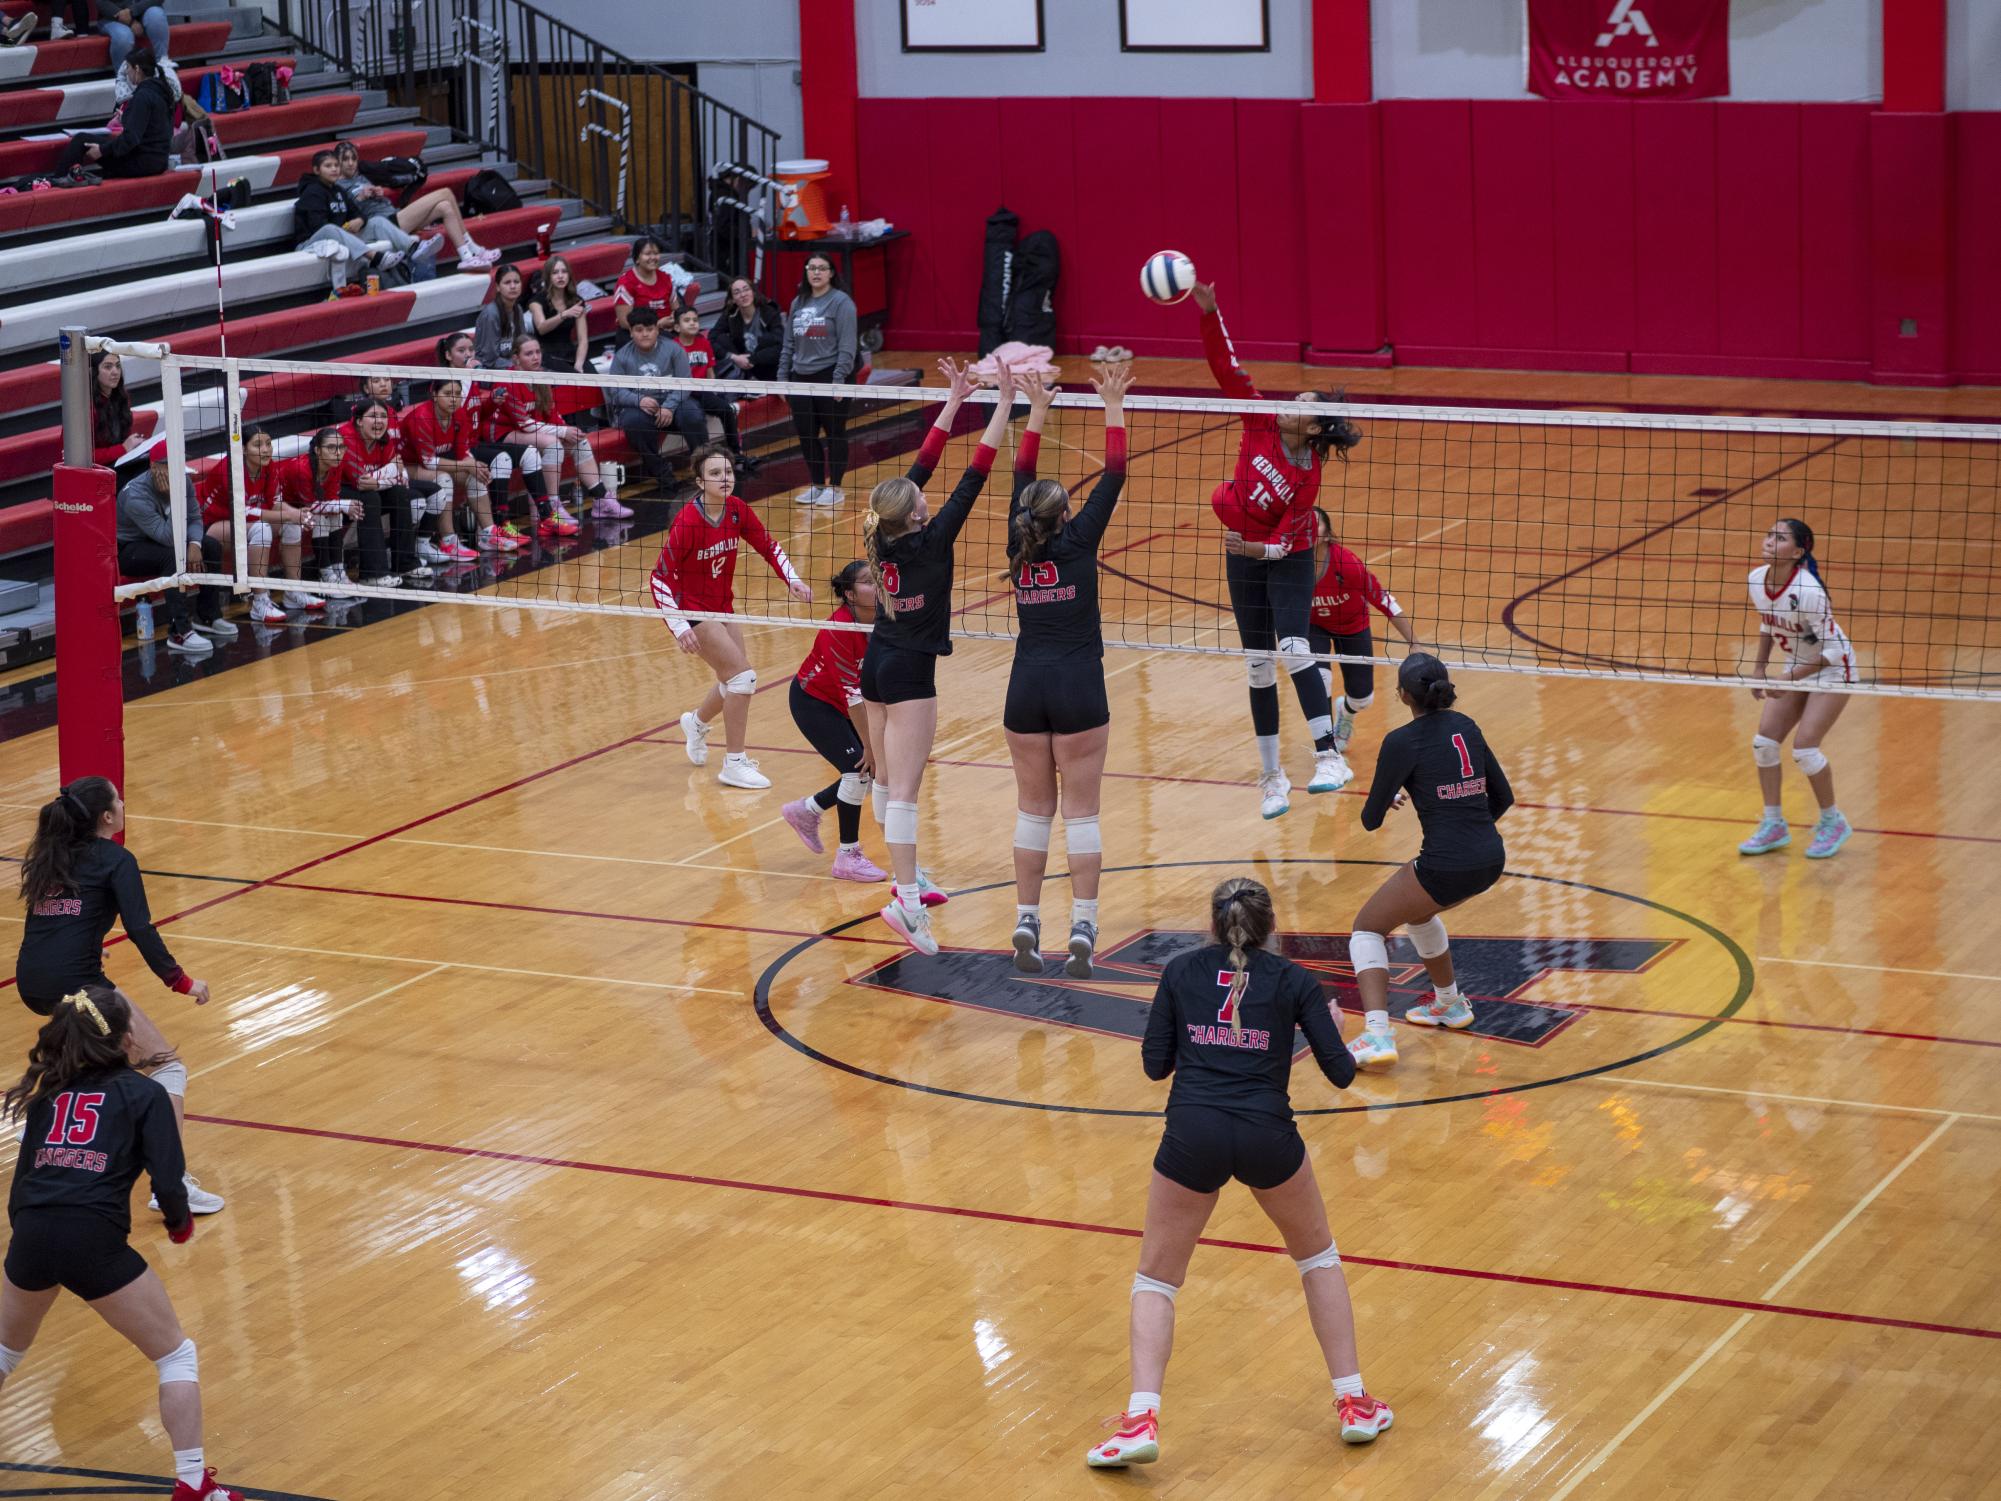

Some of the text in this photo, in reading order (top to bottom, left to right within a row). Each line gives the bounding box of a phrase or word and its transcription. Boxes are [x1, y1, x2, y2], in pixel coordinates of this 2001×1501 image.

[1554, 66, 1698, 89] ACADEMY
[1555, 54, 1696, 69] ALBUQUERQUE
[1773, 632, 1793, 654] 2
[1451, 732, 1475, 779] 1
[1216, 969, 1250, 1023] 7
[44, 1091, 106, 1145] 15
